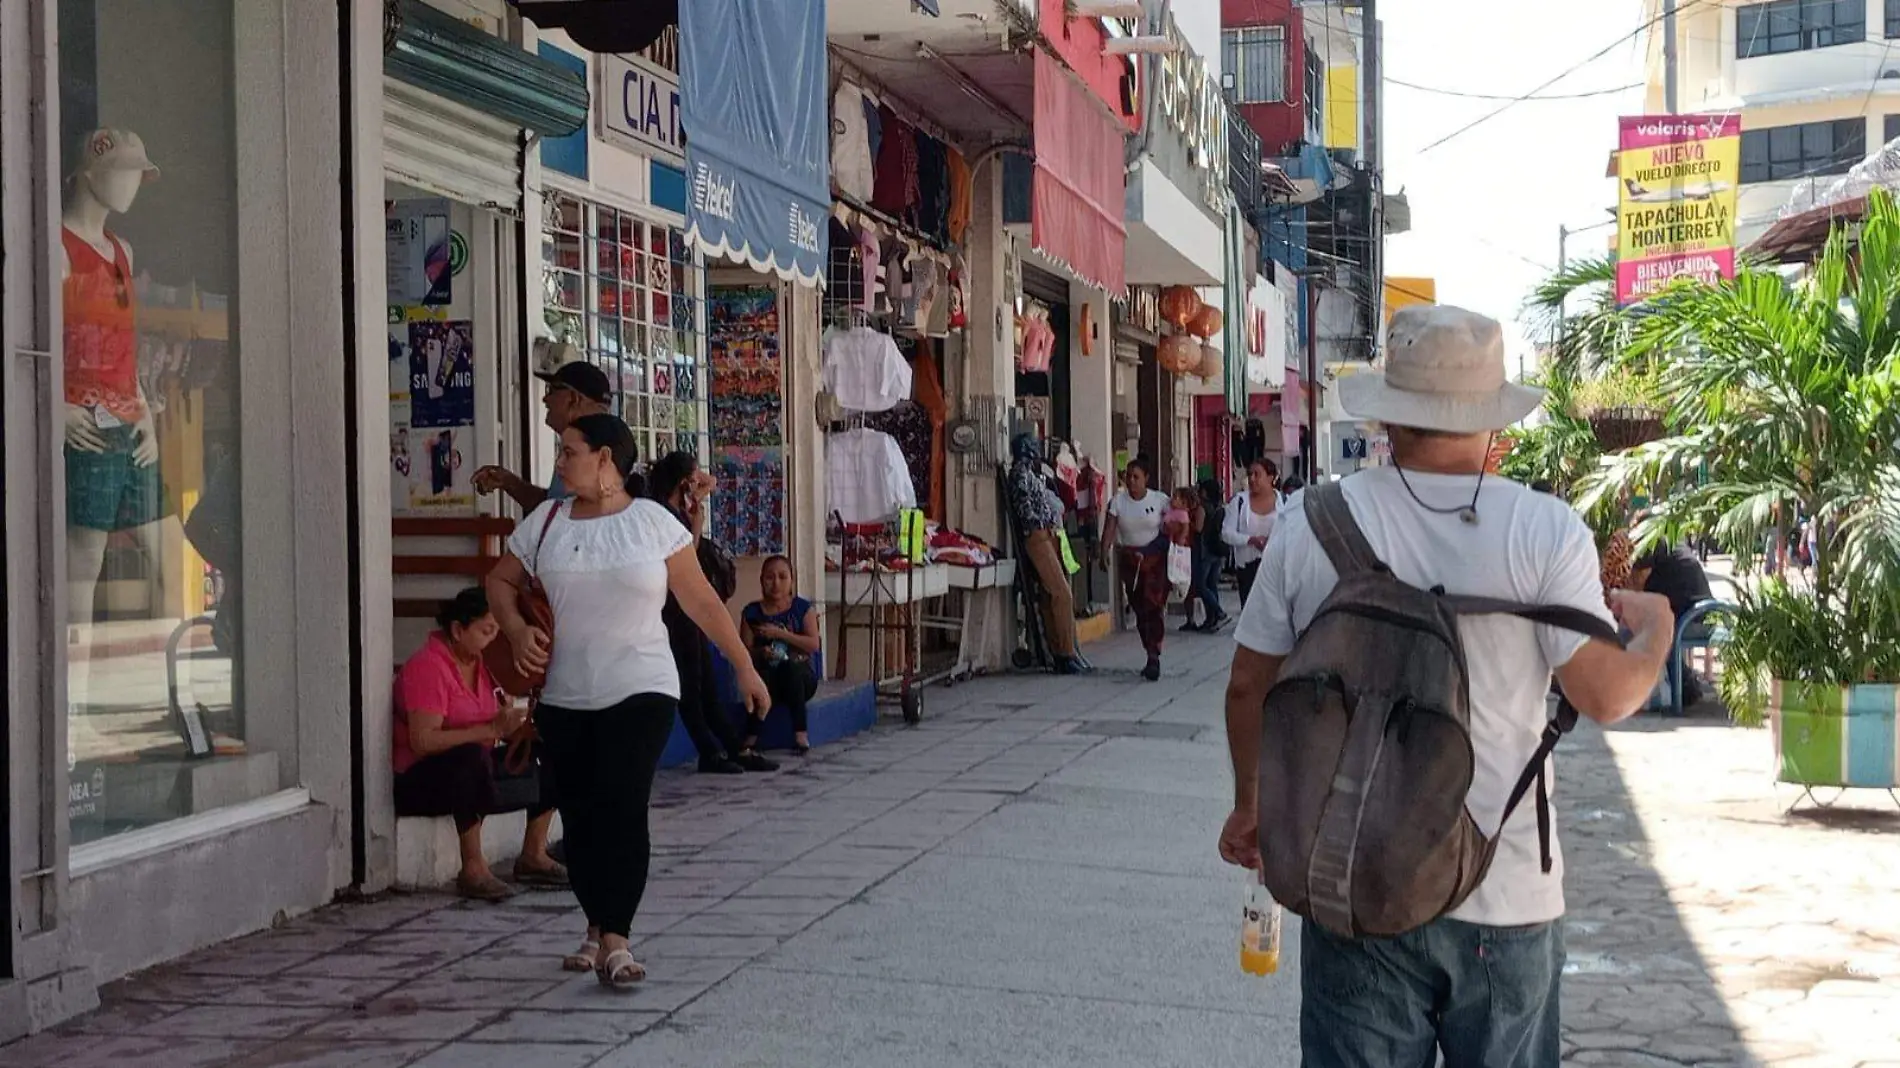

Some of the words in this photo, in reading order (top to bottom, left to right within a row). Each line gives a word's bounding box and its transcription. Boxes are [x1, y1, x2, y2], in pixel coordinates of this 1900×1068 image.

[1637, 120, 1696, 137] volaris
[1652, 143, 1705, 166] NUEVO
[1635, 167, 1672, 183] VUELO
[1674, 160, 1721, 177] DIRECTO
[703, 170, 735, 223] telcel
[1625, 202, 1715, 230] TAPACHULA
[1632, 220, 1725, 248] MONTERREY
[1637, 256, 1713, 280] BIENVENIDO
